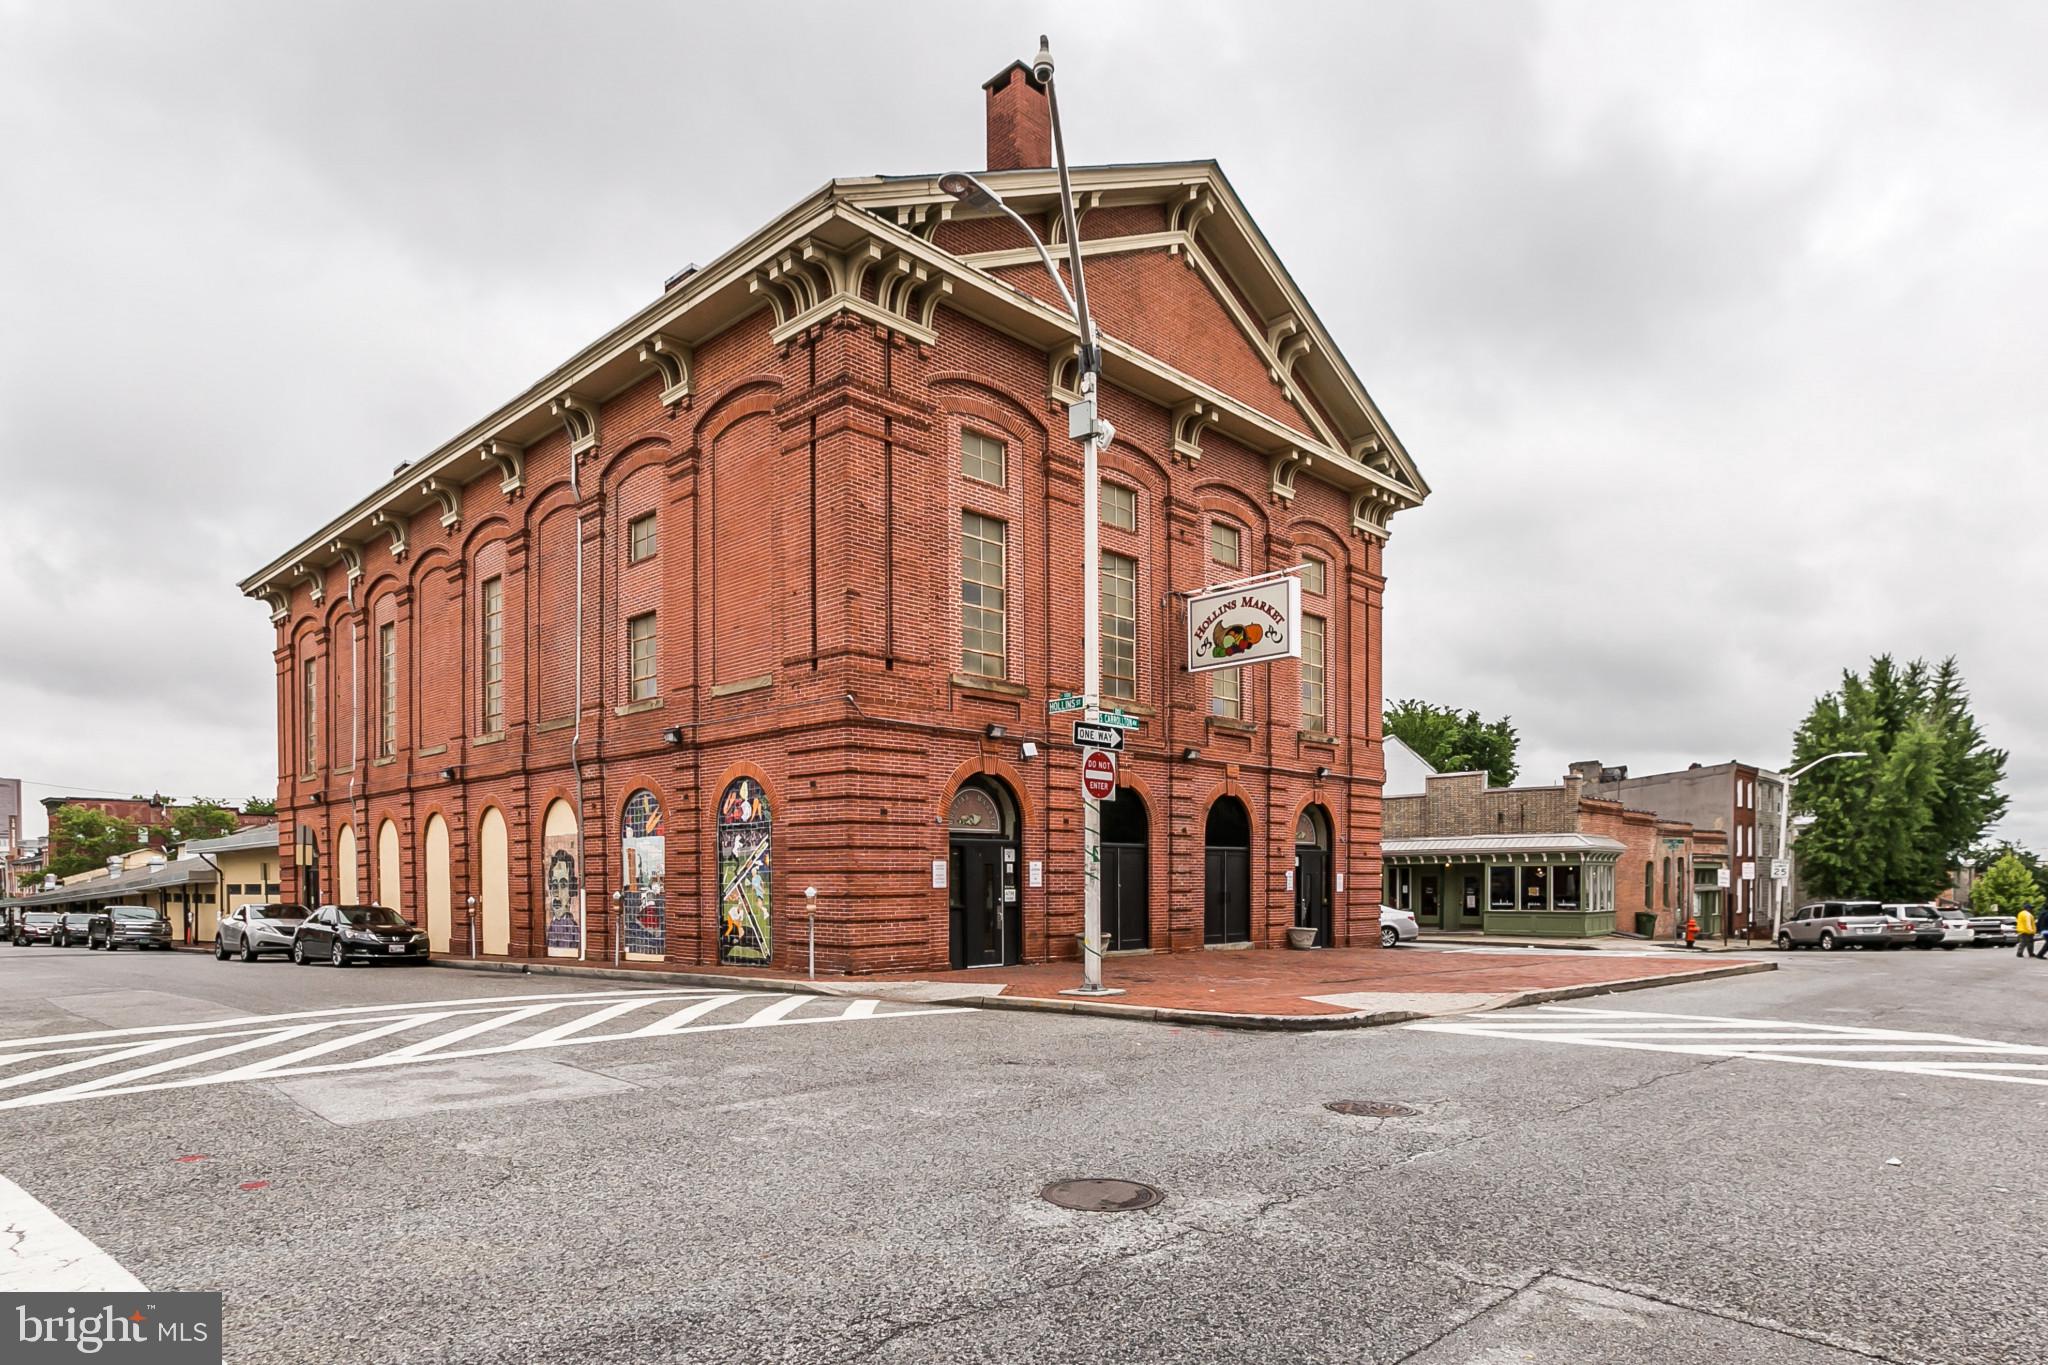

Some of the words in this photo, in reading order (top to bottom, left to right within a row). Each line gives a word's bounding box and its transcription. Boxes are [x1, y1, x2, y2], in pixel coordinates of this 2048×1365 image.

[1194, 599, 1237, 640] HOLLINS
[1241, 596, 1285, 625] MARKET
[1049, 699, 1076, 712] HOLLINS
[1079, 729, 1095, 740] ONE
[1098, 733, 1113, 742] WAY
[1088, 760, 1097, 768] DO
[1098, 761, 1111, 769] NOT
[1089, 781, 1109, 791] ENTER
[1774, 868, 1787, 876] 25
